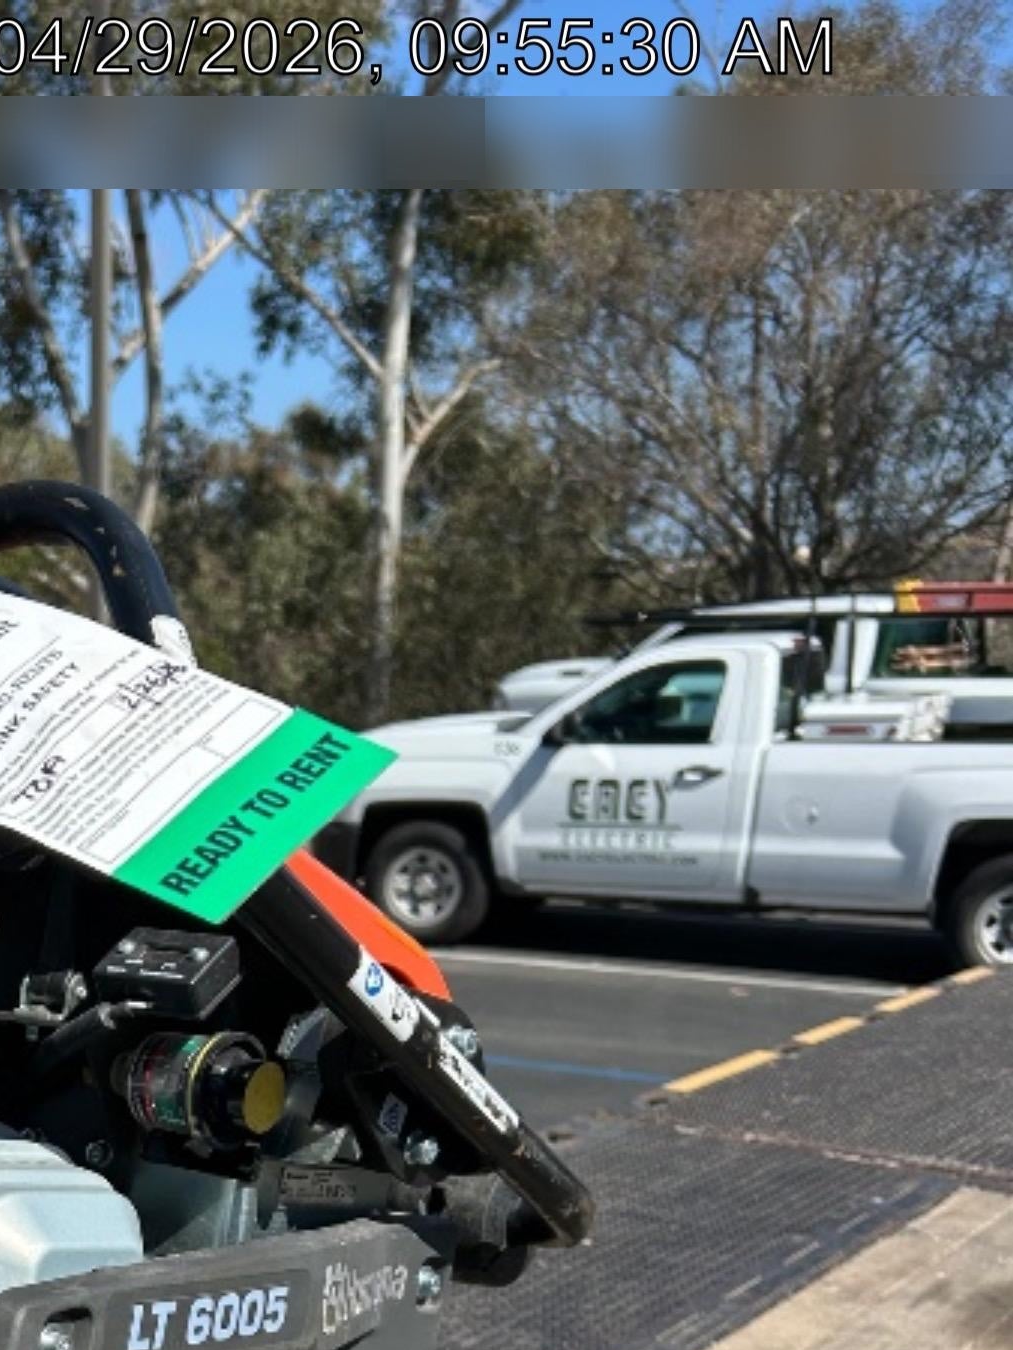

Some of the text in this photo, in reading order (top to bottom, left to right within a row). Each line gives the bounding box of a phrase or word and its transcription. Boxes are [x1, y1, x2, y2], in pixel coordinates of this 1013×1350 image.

[20, 660, 80, 712] SAFETY
[158, 730, 353, 896] READY TO RENT
[187, 1285, 289, 1345] 6005
